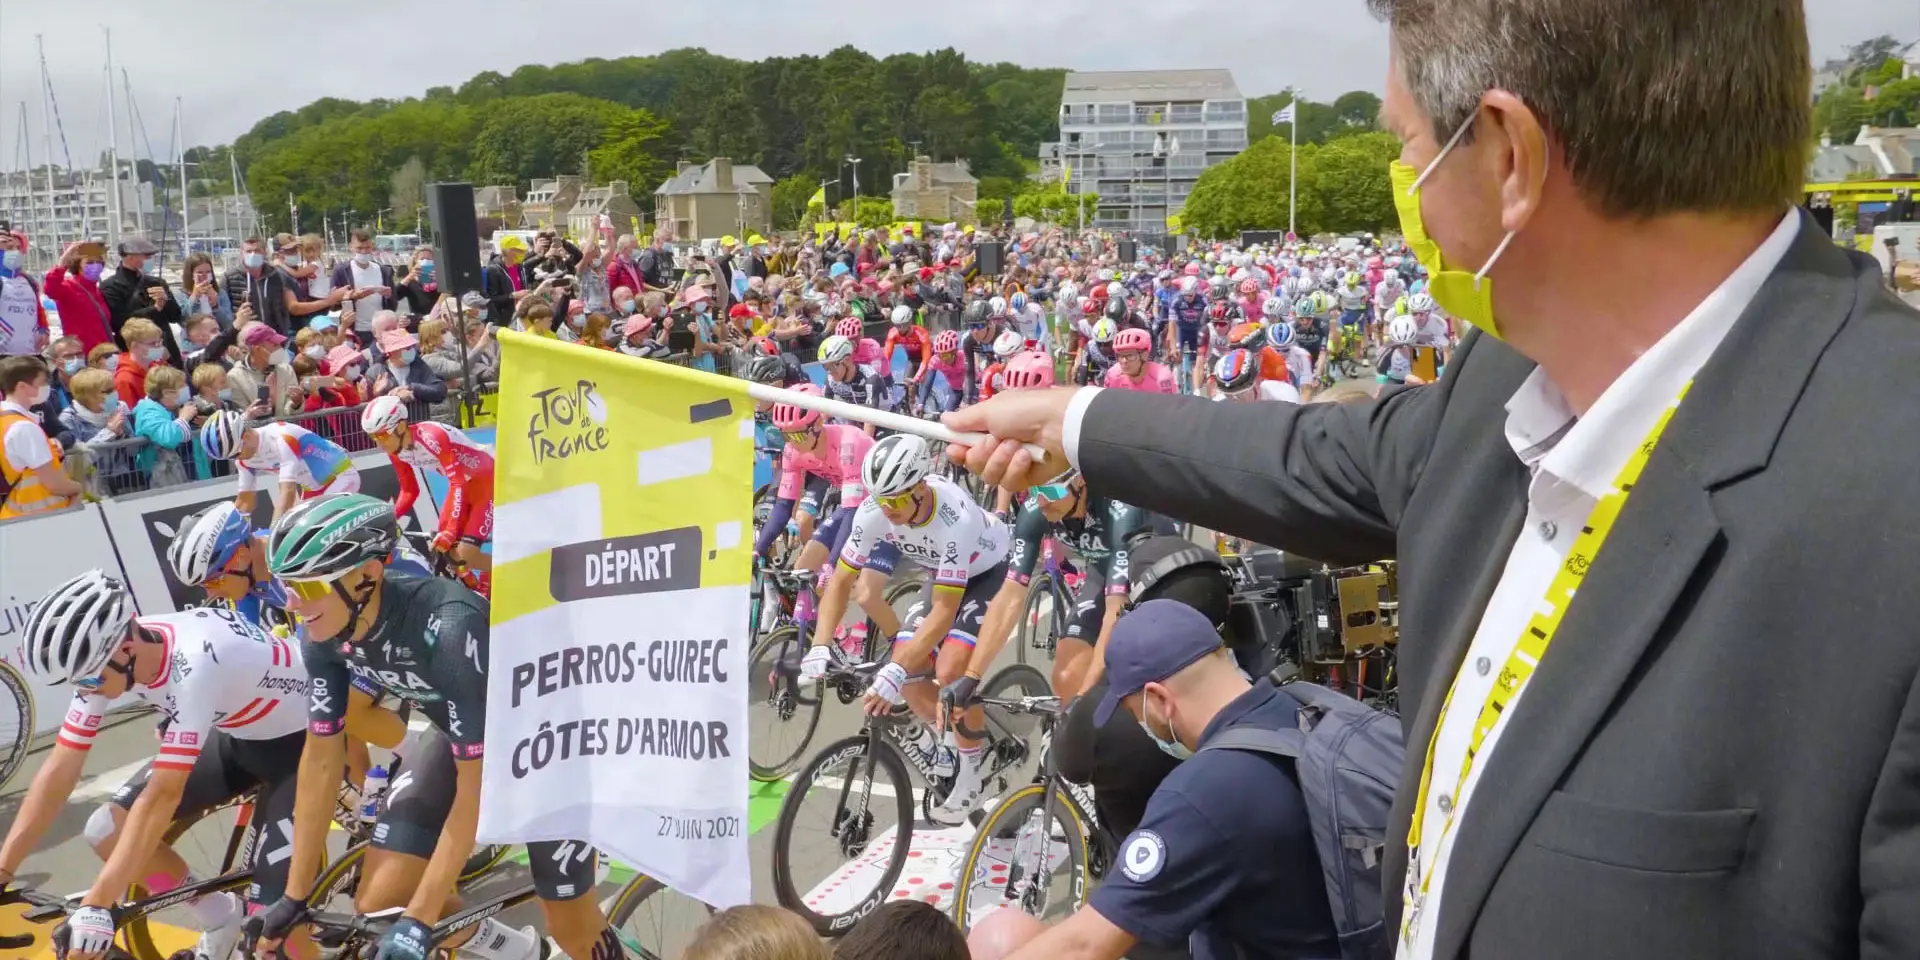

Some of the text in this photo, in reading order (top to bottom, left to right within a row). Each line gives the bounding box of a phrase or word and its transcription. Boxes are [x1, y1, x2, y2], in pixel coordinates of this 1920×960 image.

[531, 380, 596, 429] TOUR
[581, 412, 591, 429] de
[941, 502, 960, 523] BORA
[585, 542, 676, 588] DÉPART
[511, 639, 728, 708] PERROS-GUIREC
[511, 718, 731, 779] CÔTES D'ARMOR
[657, 815, 673, 837] 27
[706, 816, 739, 840] 2021
